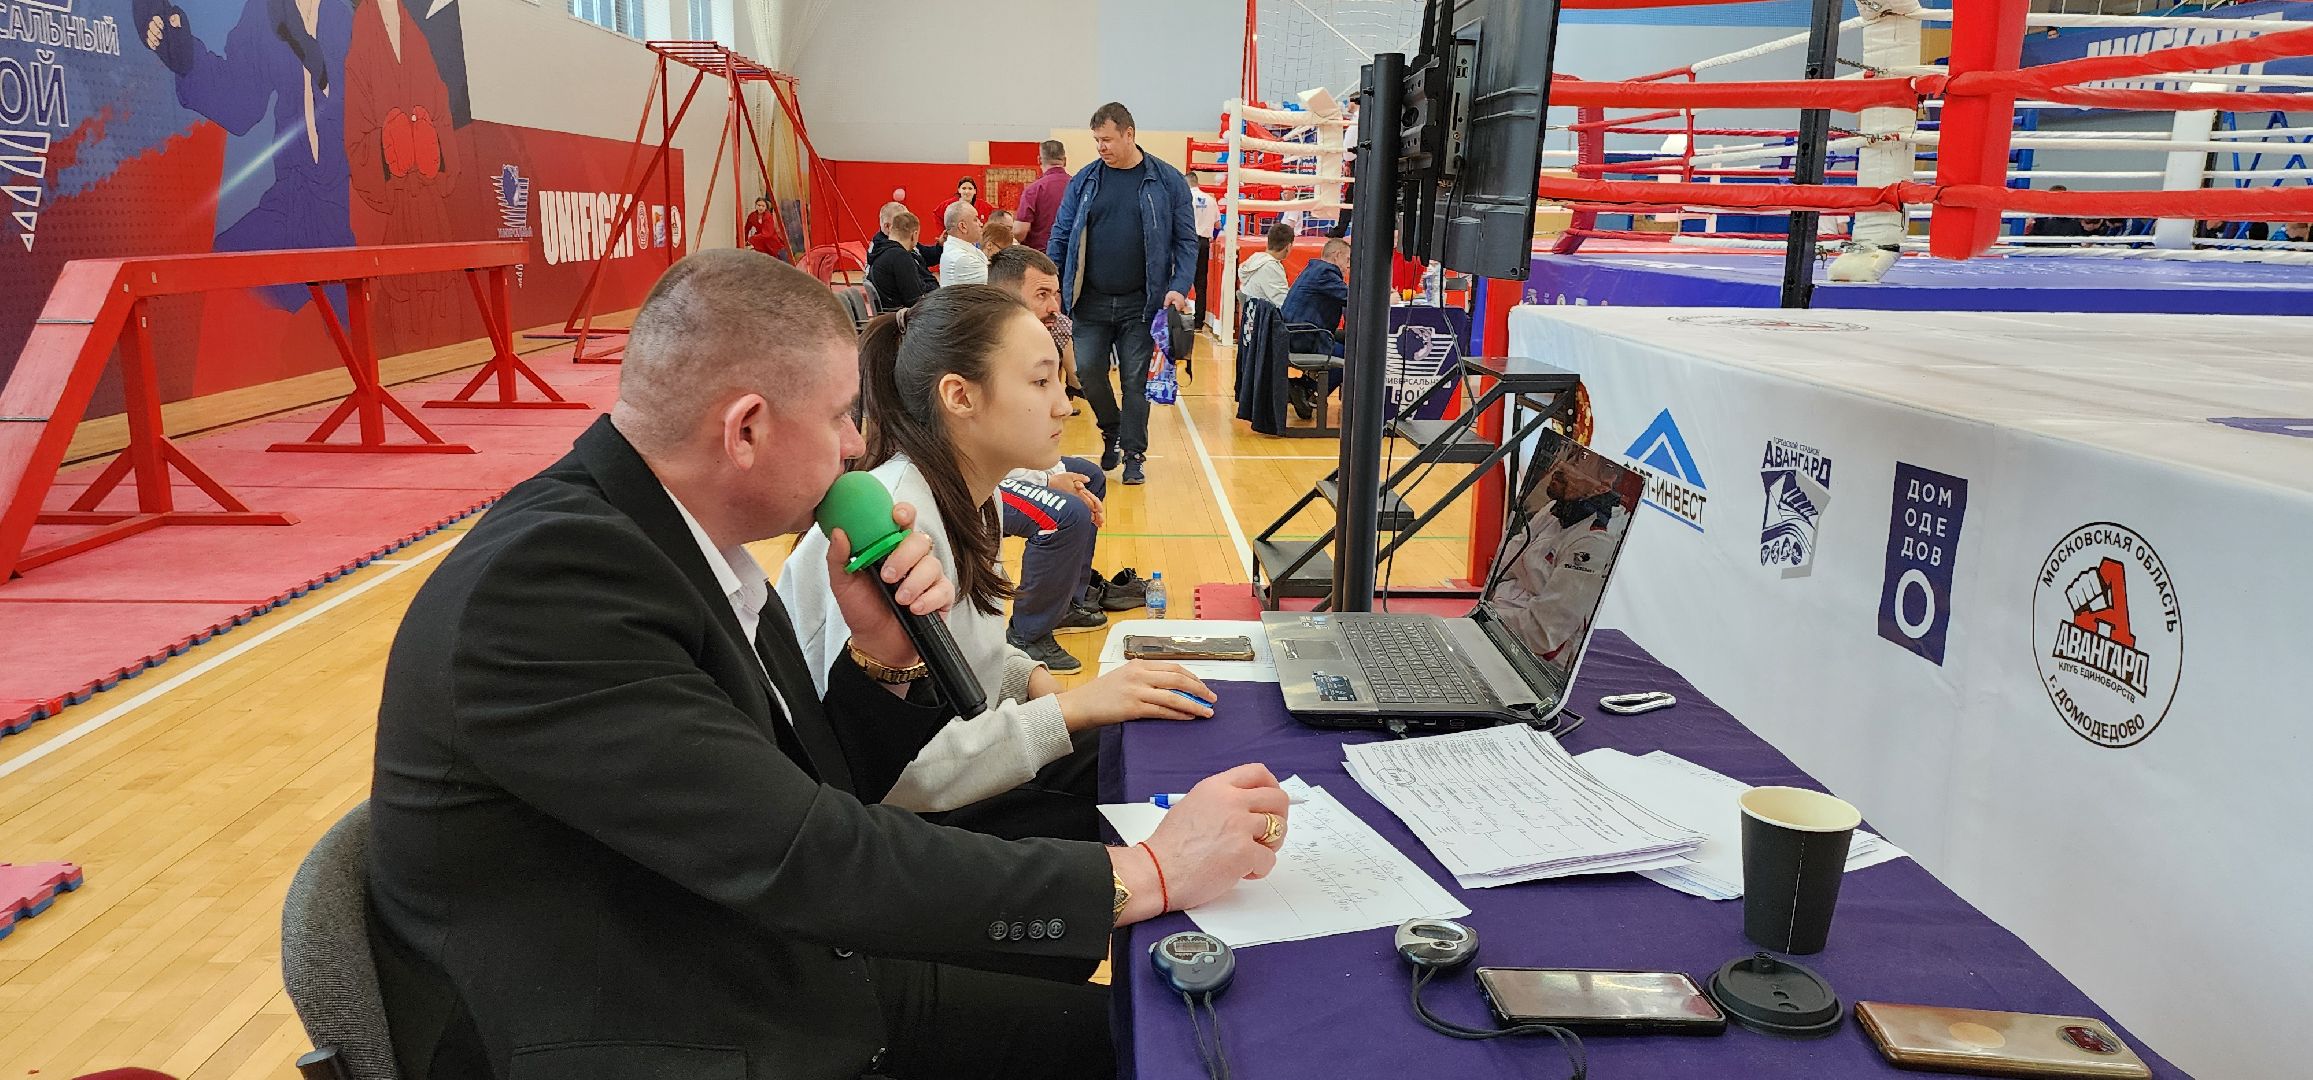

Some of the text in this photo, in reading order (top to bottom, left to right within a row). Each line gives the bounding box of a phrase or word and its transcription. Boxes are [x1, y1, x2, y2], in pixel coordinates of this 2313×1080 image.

[1762, 441, 1832, 490] АВАНГАРД
[1907, 479, 1952, 508] ДОМ
[1904, 508, 1948, 537] ОДЕ
[1901, 537, 1942, 567] ДОВ
[2042, 529, 2178, 633] МОСКОВСКАЯ ОБЛАСТЬ
[2053, 620, 2149, 697] АВАНГАРД
[2058, 661, 2136, 704] КЛУБ ЕДИНОБОРСТВ
[2055, 688, 2145, 742] ДОМОДЕДОВО
